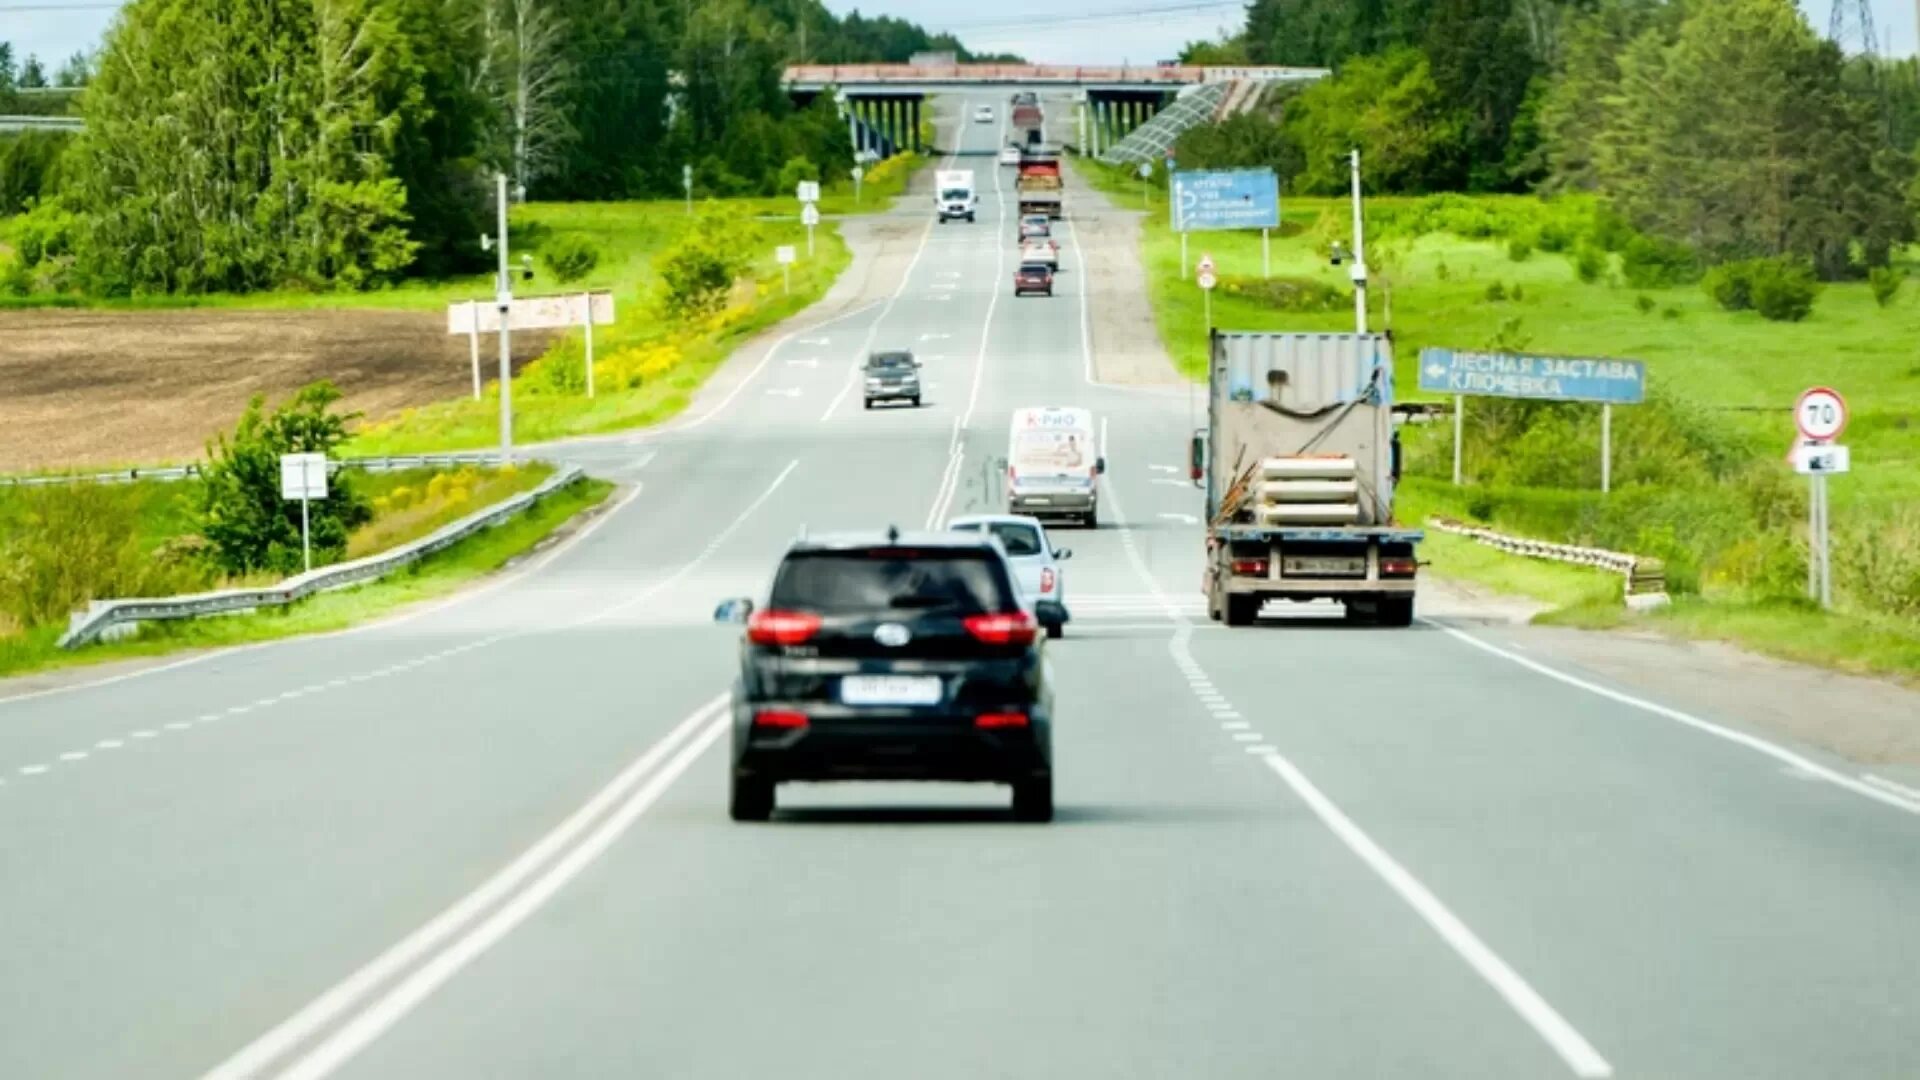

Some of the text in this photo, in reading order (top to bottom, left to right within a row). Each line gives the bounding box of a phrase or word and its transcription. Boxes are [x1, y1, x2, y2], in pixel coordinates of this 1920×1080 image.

[1450, 351, 1638, 380] ЛЕСНАЯ ЗАСТАВА
[1449, 372, 1562, 395] КЛЮЧЕВКА
[1808, 404, 1835, 425] 70
